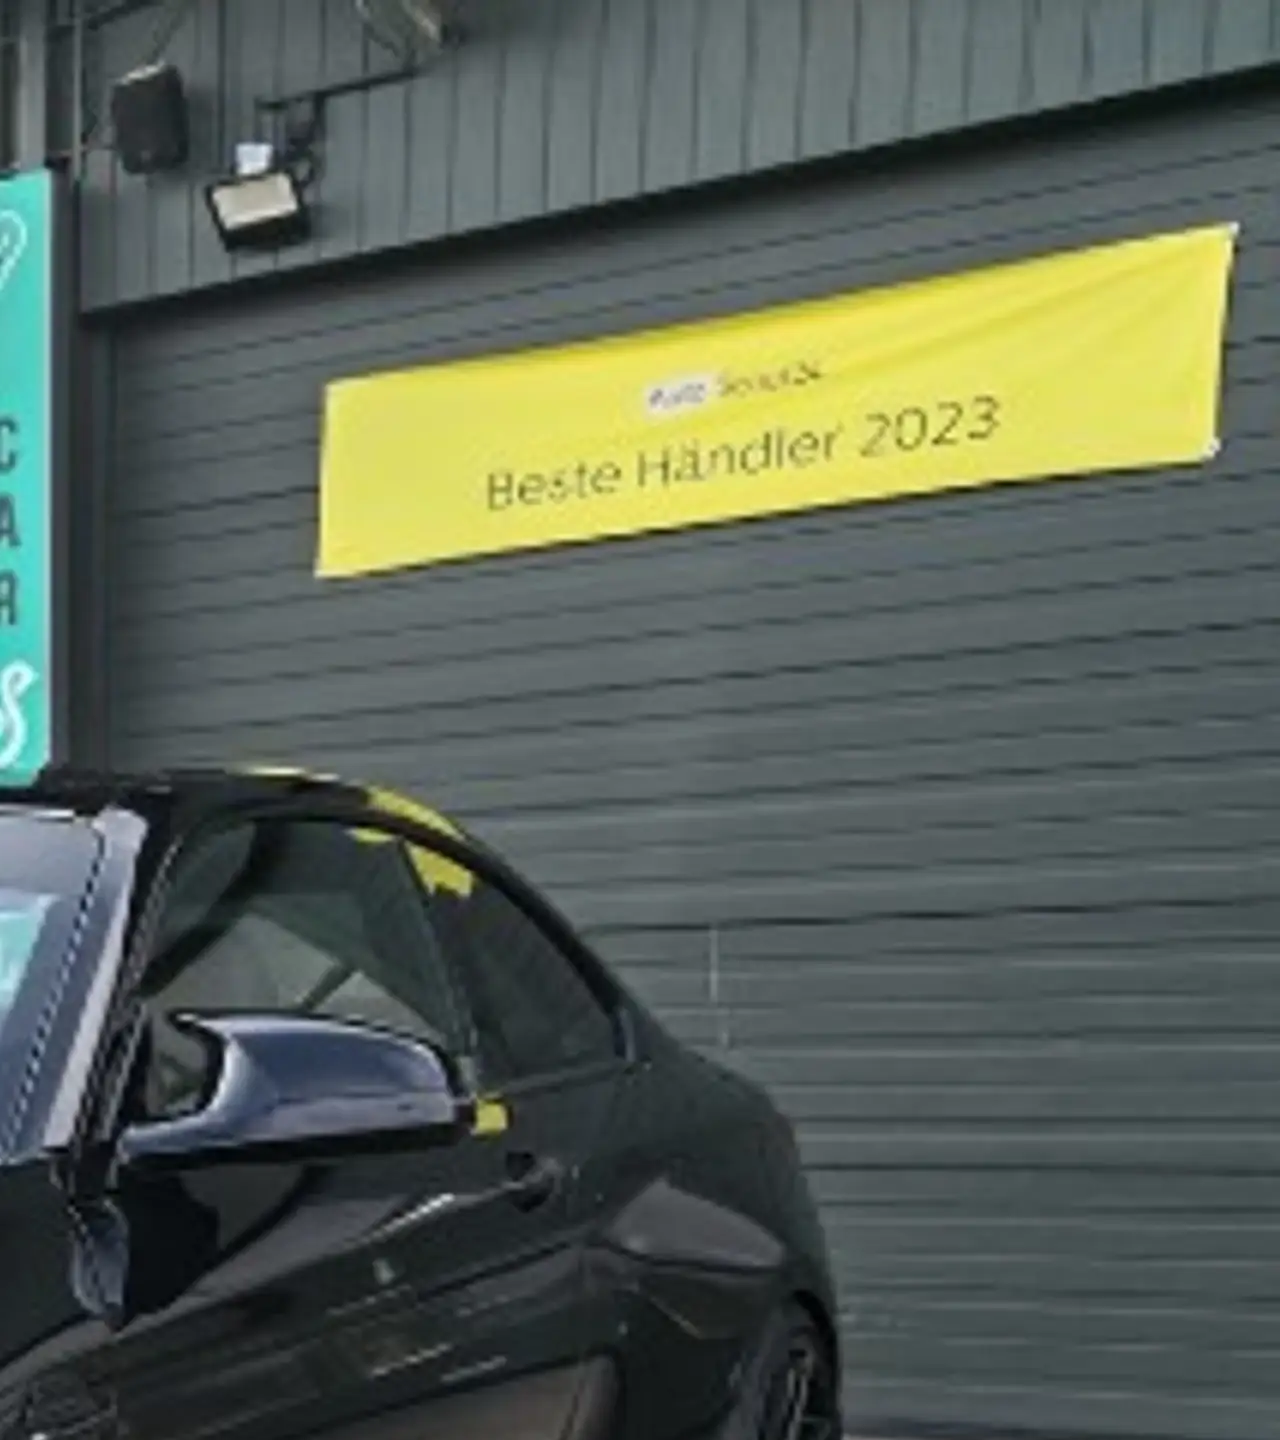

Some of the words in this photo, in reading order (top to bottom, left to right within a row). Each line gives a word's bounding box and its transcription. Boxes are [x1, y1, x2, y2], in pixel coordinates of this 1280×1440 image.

[487, 461, 623, 510] Beste
[638, 424, 844, 489] Händler
[859, 396, 1002, 459] 2023
